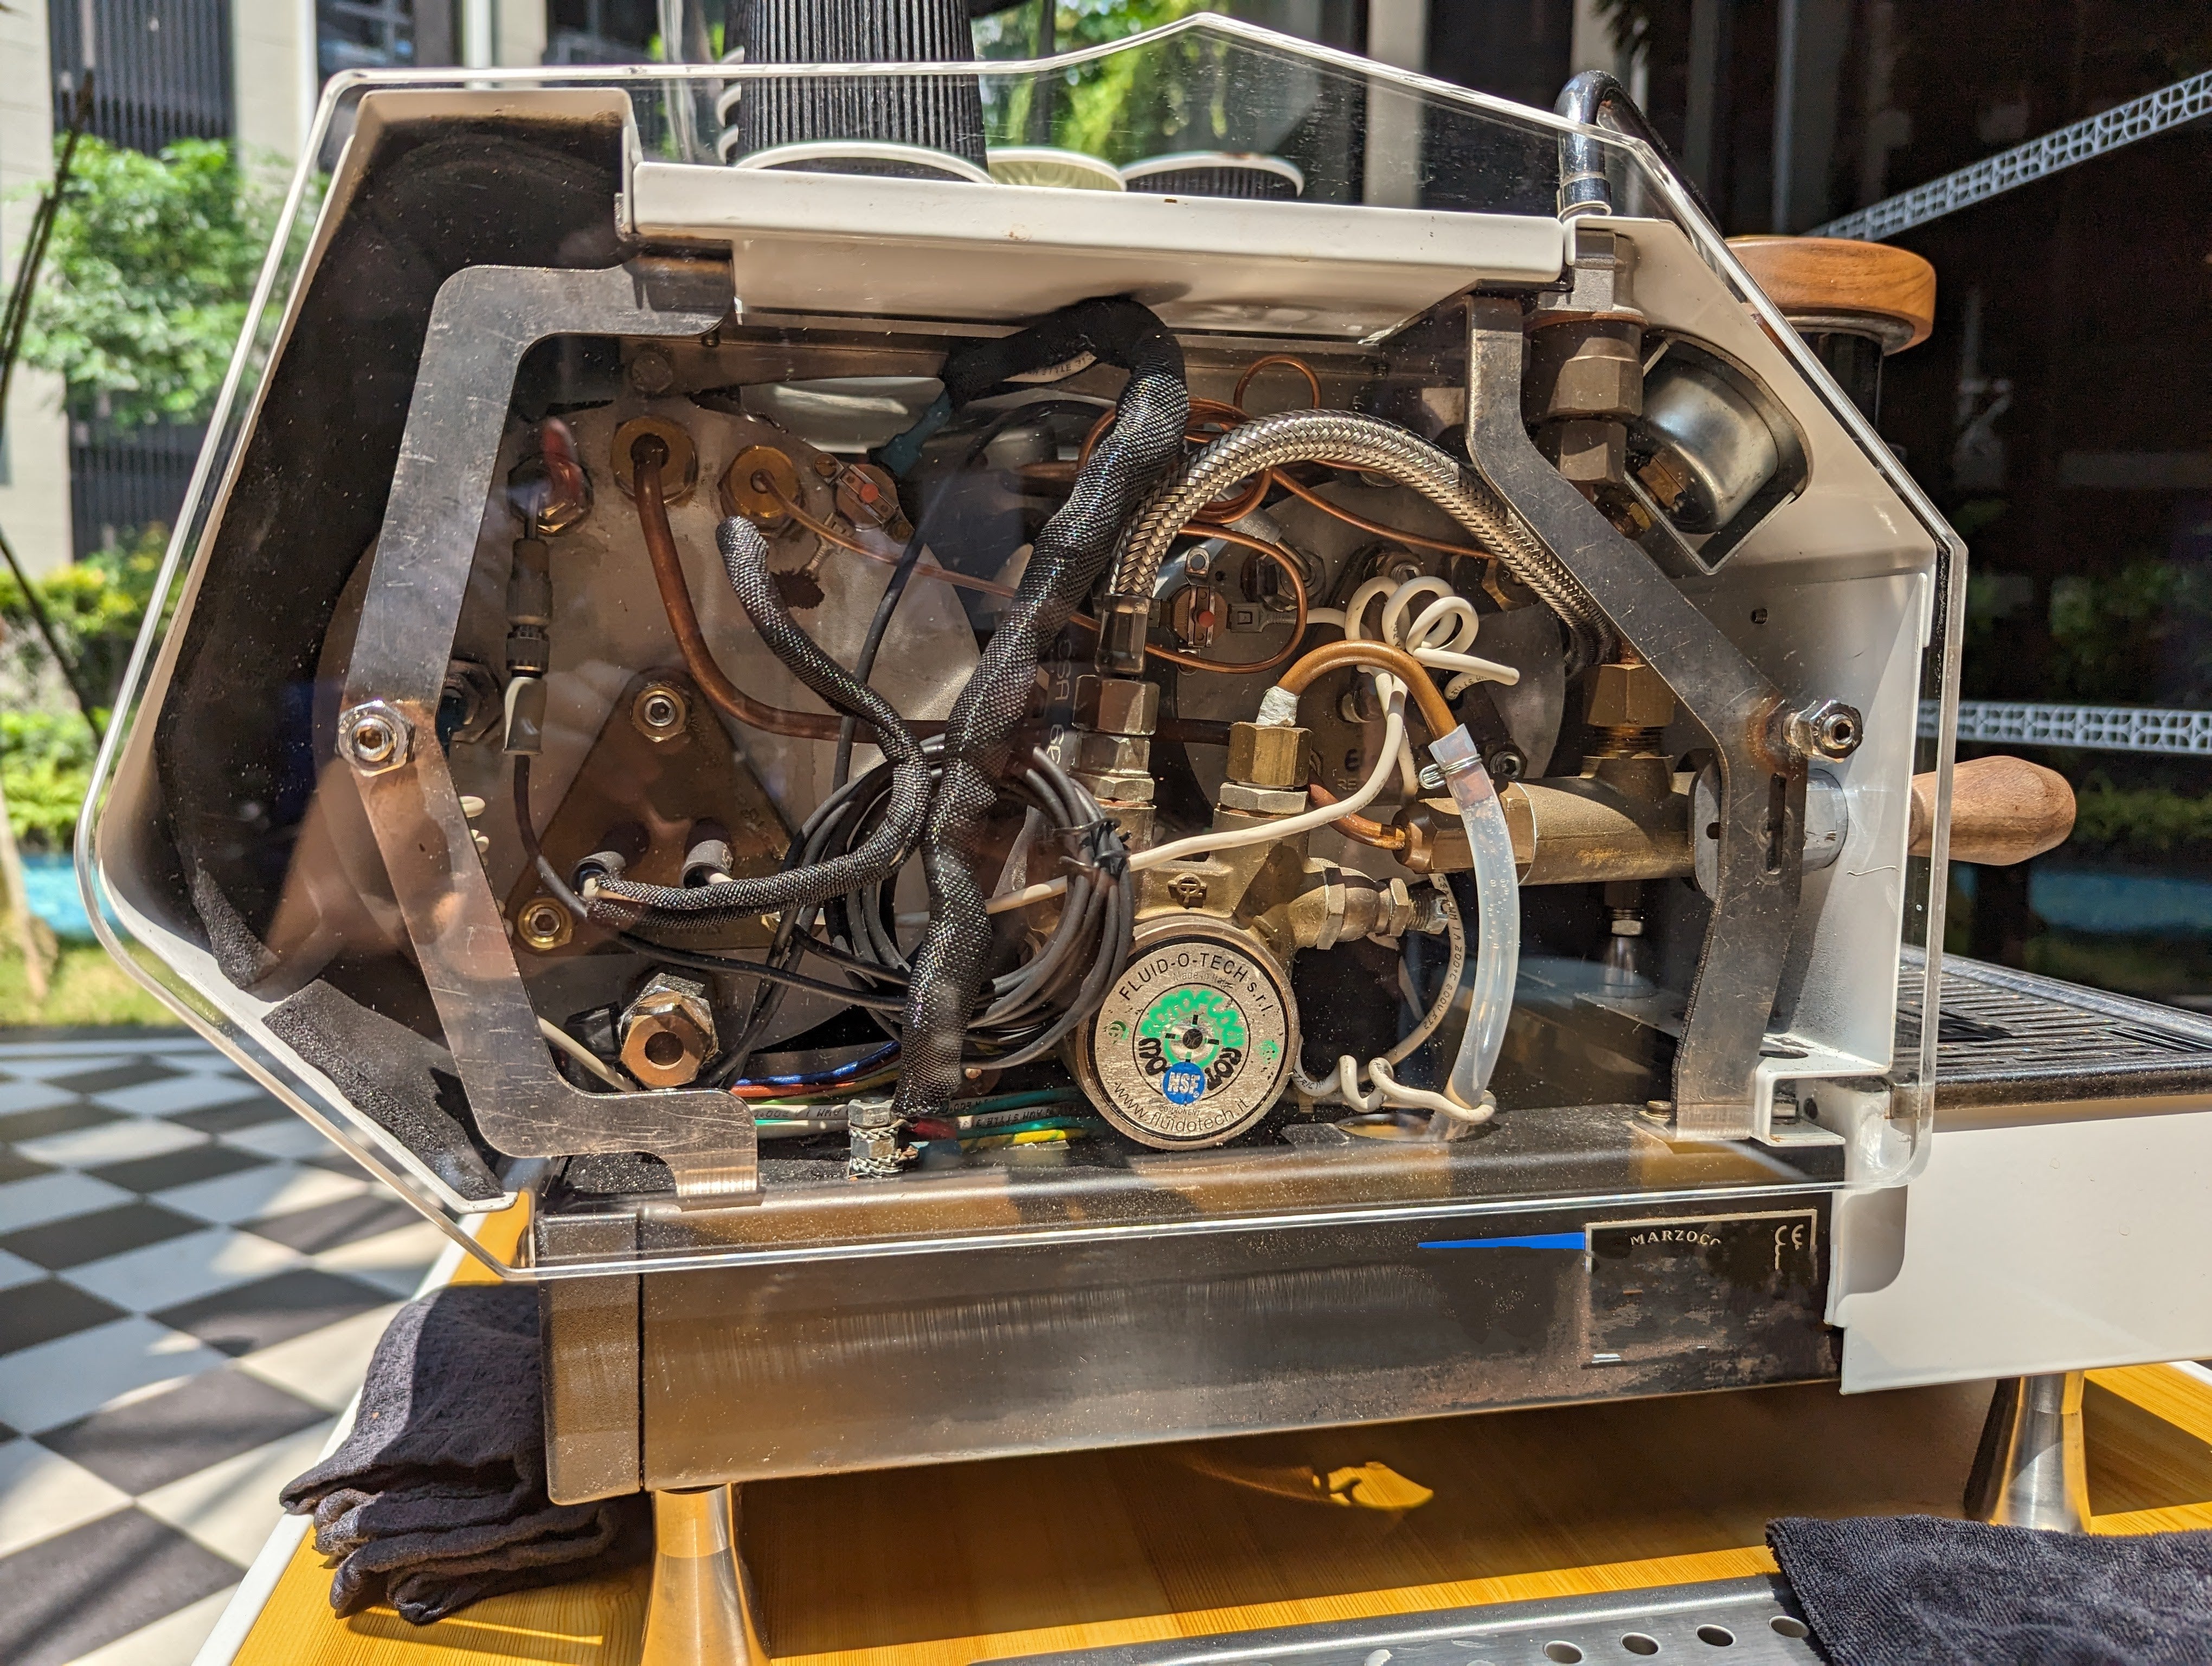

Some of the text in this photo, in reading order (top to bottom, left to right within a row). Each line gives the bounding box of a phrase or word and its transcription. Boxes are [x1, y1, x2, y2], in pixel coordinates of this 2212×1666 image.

[1120, 952, 1248, 1001] FLUID-O-TECH
[1173, 972, 1199, 982] Made
[1436, 983, 1452, 1012] 600V
[1167, 1072, 1200, 1094] NSF
[1114, 1081, 1249, 1132] www.fluidotech.it
[1159, 1105, 1201, 1116] COMPONENT
